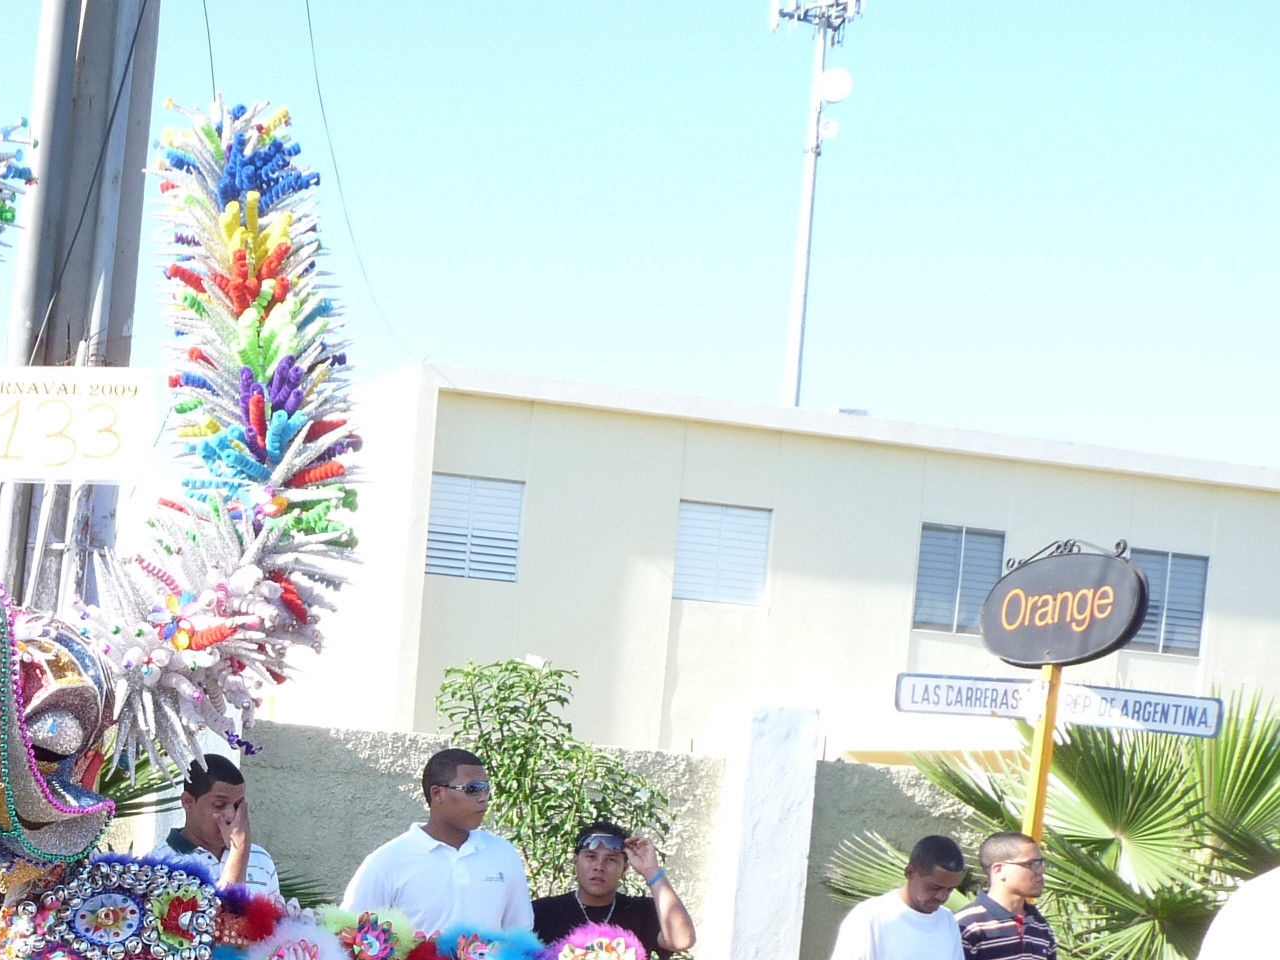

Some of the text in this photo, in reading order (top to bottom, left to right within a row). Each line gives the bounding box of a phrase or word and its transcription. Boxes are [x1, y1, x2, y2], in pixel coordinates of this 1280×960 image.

[89, 383, 138, 397] 2009
[1001, 584, 1114, 631] Orange
[911, 683, 1020, 710] LAS CARRERAS
[1121, 699, 1208, 728] ARGENTINA
